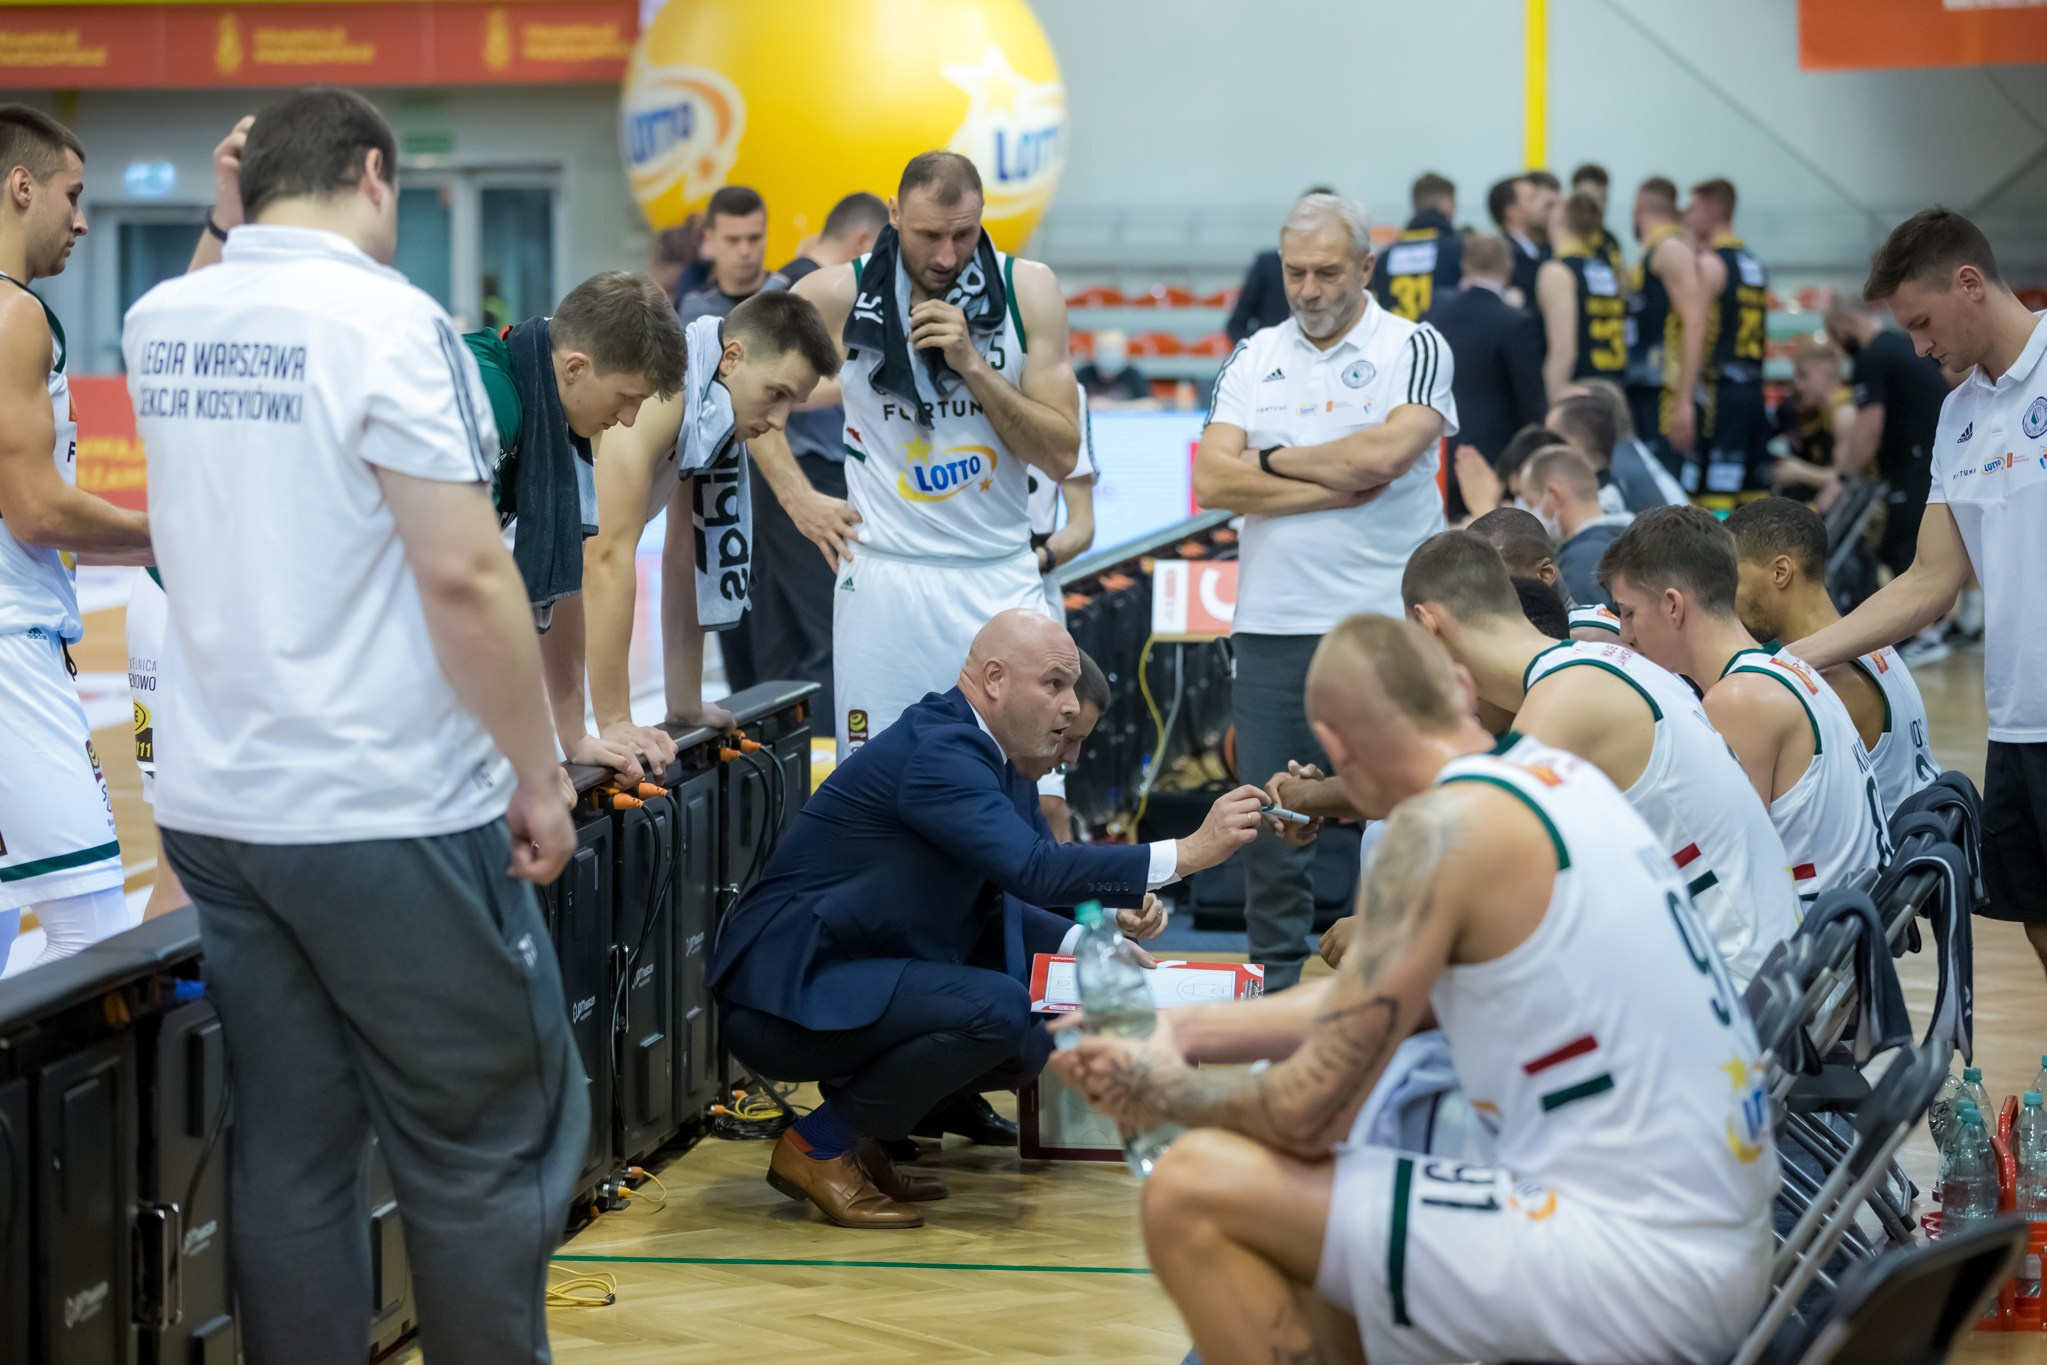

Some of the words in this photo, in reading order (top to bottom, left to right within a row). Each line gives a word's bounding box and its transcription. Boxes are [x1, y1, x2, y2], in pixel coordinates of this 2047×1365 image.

[193, 341, 307, 383] WARSZAWA
[989, 330, 1006, 371] 5
[882, 400, 984, 421] FRTUN
[914, 455, 981, 492] LOTTO
[1984, 459, 2002, 472] LOTTO
